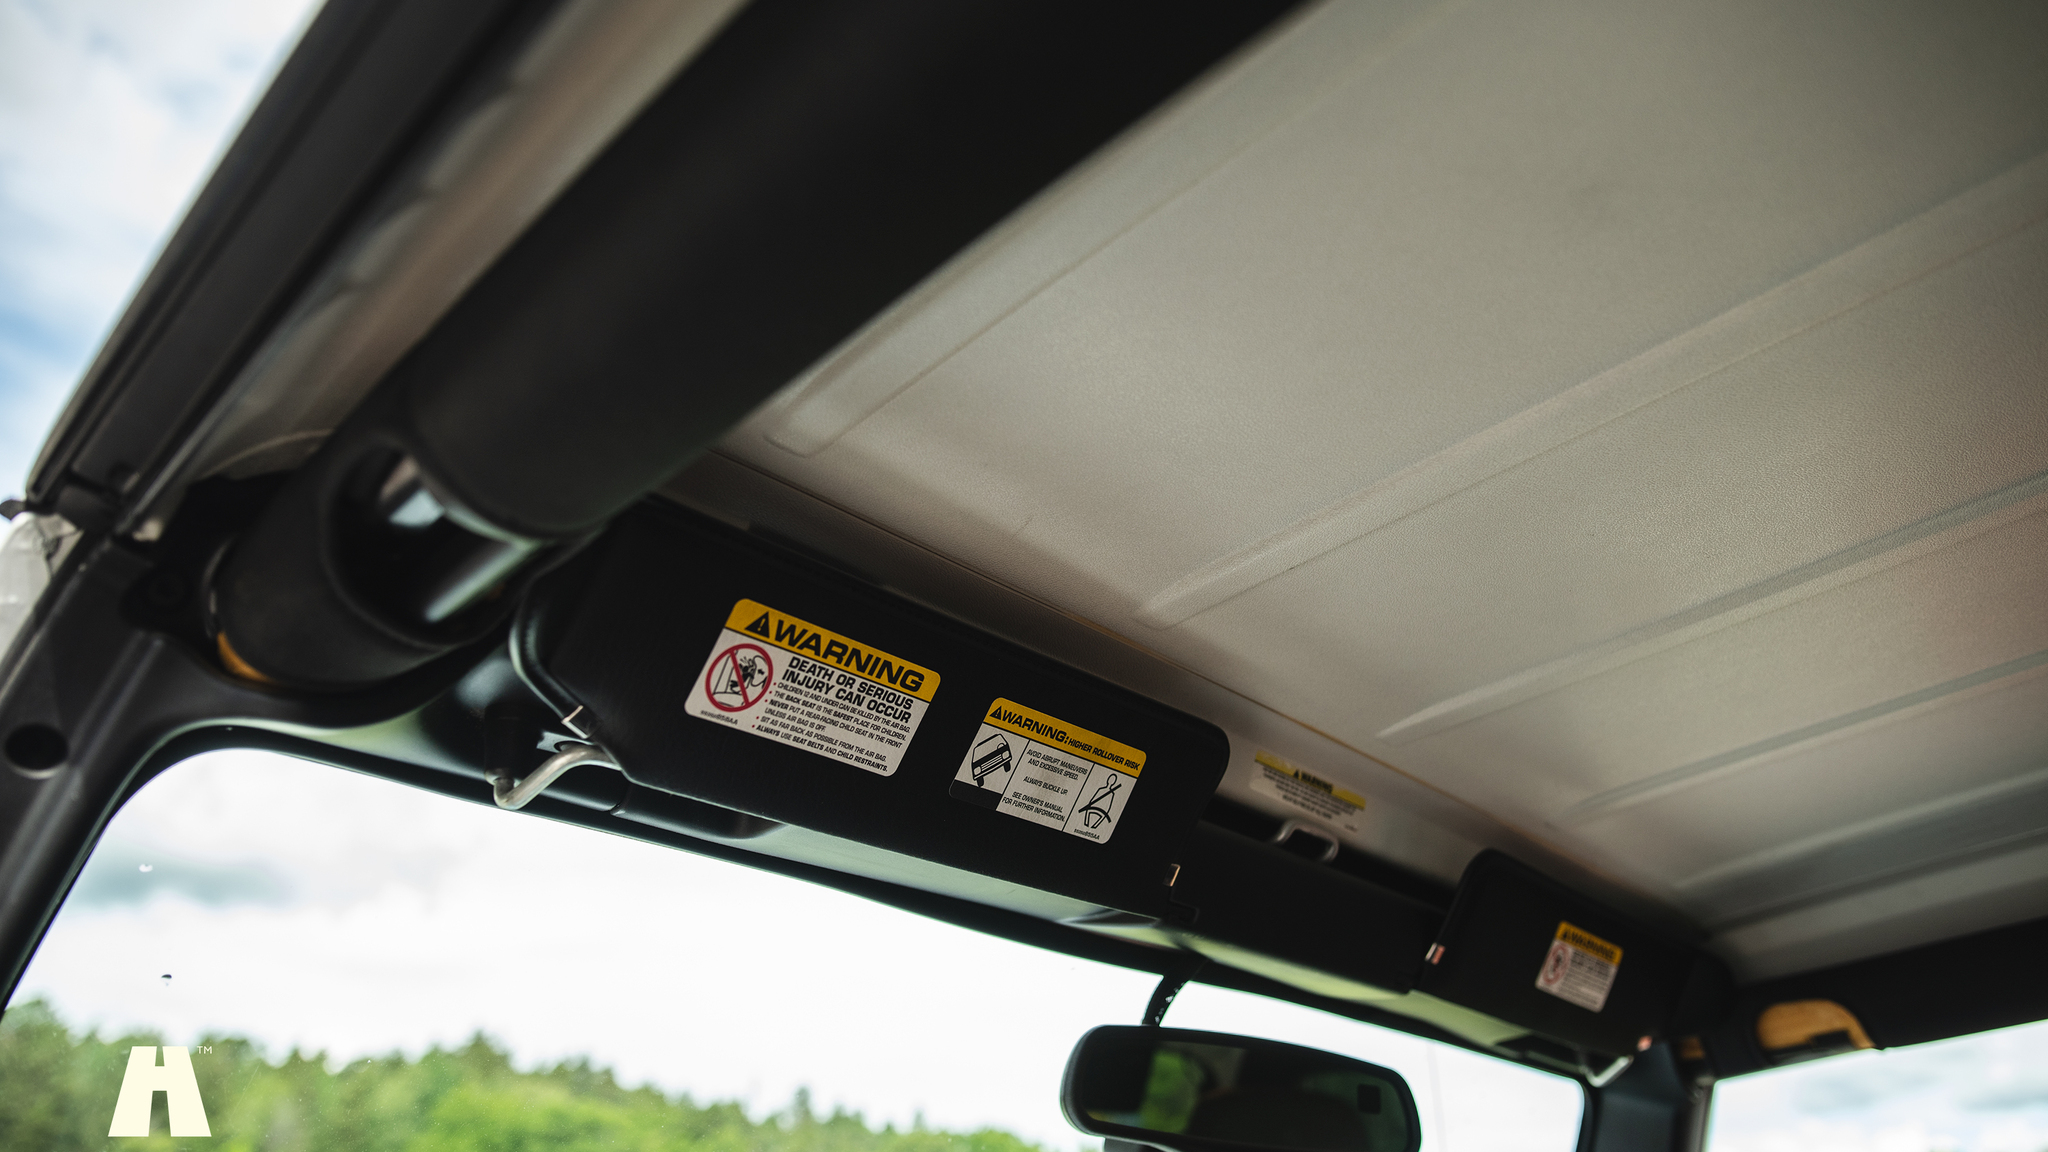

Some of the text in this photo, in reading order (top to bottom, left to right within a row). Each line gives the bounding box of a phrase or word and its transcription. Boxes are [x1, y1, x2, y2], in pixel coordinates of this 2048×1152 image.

[775, 619, 925, 693] WARNING
[781, 668, 912, 724] INJURY CAN OCCUR
[788, 656, 914, 710] DEATH OR SERIOUS
[764, 707, 787, 720] UNLESS
[786, 714, 797, 723] AIR
[796, 717, 810, 727] BAG
[808, 721, 816, 729] IS
[769, 699, 789, 710] NEVER
[788, 705, 801, 714] PUT
[804, 710, 840, 727] REAR-FACING
[838, 722, 856, 733] CHILD
[854, 727, 869, 737] SEAT
[874, 734, 886, 743] THE
[884, 738, 903, 749] FRONT
[774, 690, 786, 700] THE
[785, 694, 802, 705] BACK
[801, 699, 817, 709] SEAT
[815, 704, 823, 712] IS
[822, 706, 834, 716] THE
[832, 710, 854, 722] SAFEST
[852, 717, 871, 729] PLACE
[869, 723, 882, 732] FOR
[777, 682, 804, 696] CHILDREN
[803, 690, 811, 698] 12
[808, 693, 822, 702] AND
[821, 697, 840, 708] UNDER
[838, 702, 851, 712] CAN
[849, 706, 858, 715] BE
[856, 709, 875, 720] KILLED
[873, 715, 882, 723] BY
[880, 717, 892, 727] THE
[890, 721, 900, 729] AIR
[756, 724, 781, 737] ALWAYS
[780, 732, 793, 741] USE
[792, 735, 808, 745] SEAT
[806, 740, 825, 751] BELTS
[823, 746, 838, 755] AND
[836, 750, 854, 760] CHILD
[760, 715, 771, 724] SIT
[769, 719, 779, 727] AS
[778, 721, 791, 730] FAR
[789, 725, 806, 735] BACK
[804, 730, 814, 738] AS
[813, 732, 839, 746] POSSIBLE
[837, 740, 855, 751] FROM
[854, 745, 866, 755] THE
[864, 750, 876, 758] AIR
[1002, 709, 1141, 771] WARNING: HIGHER ROLLOVER RISK
[1026, 748, 1088, 775] AVOID ABRUPT MANEUVERS
[1027, 758, 1040, 767] AND
[1039, 761, 1064, 775] EXCESSIVE
[1001, 796, 1013, 805] FOR
[1011, 799, 1035, 812] FURTHER
[1011, 791, 1063, 813] SEE OWNER'S MANUAL
[1023, 776, 1044, 787] ALWAYS
[1042, 782, 1061, 794] BUCKLE
